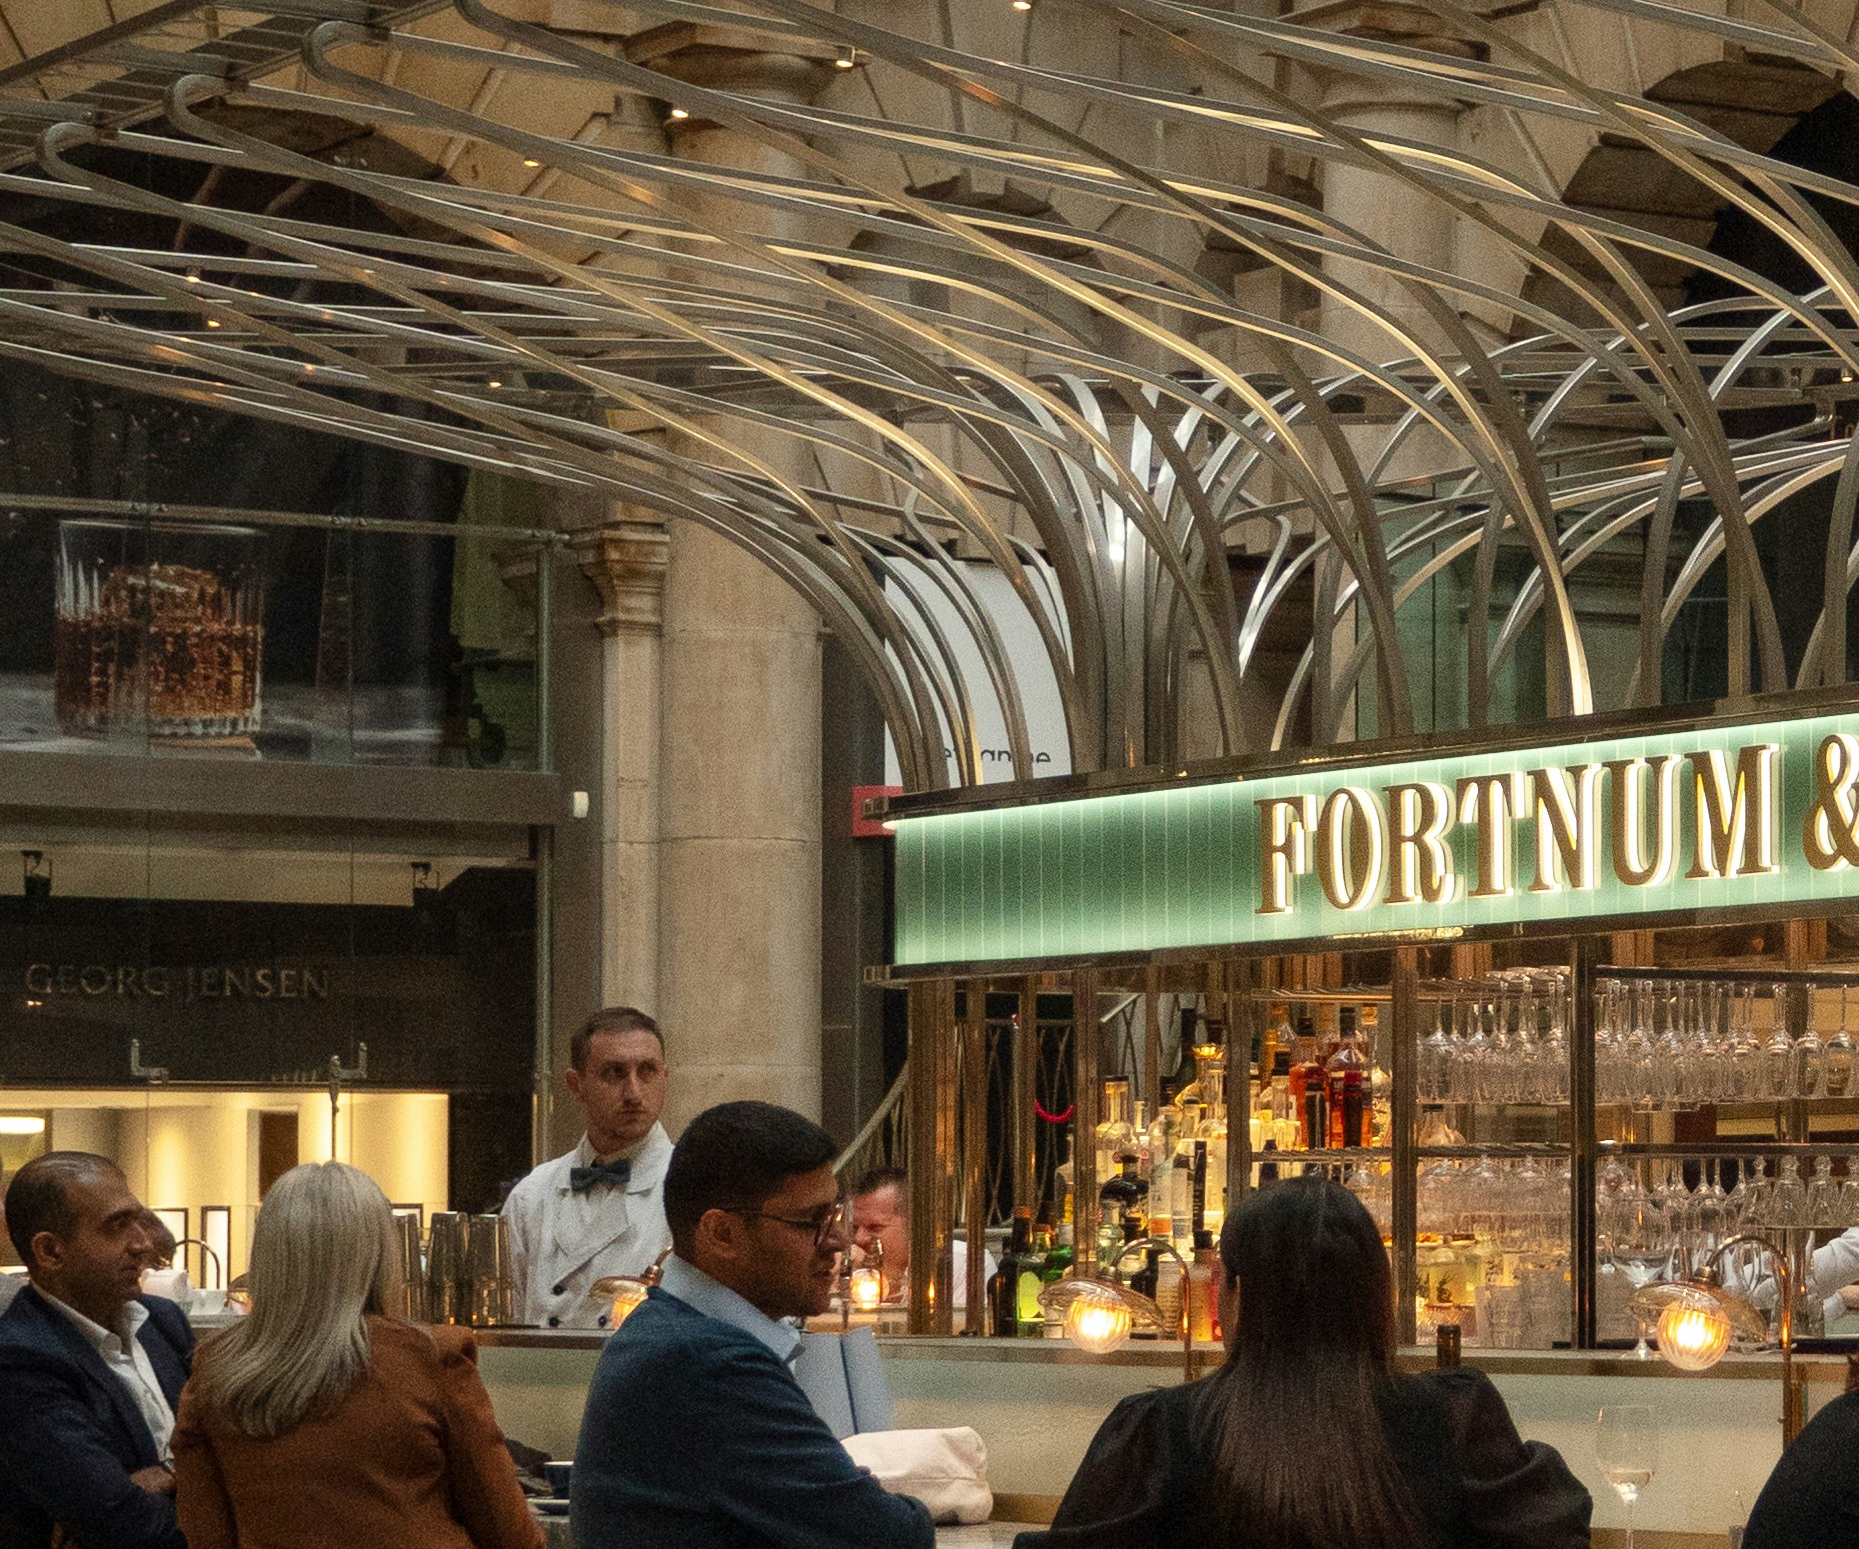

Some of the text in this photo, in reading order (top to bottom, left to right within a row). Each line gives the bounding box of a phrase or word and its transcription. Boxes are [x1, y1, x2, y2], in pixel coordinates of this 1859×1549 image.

[1254, 743, 1783, 915] FORTNUM
[25, 963, 329, 999] GEORG JENSEN
